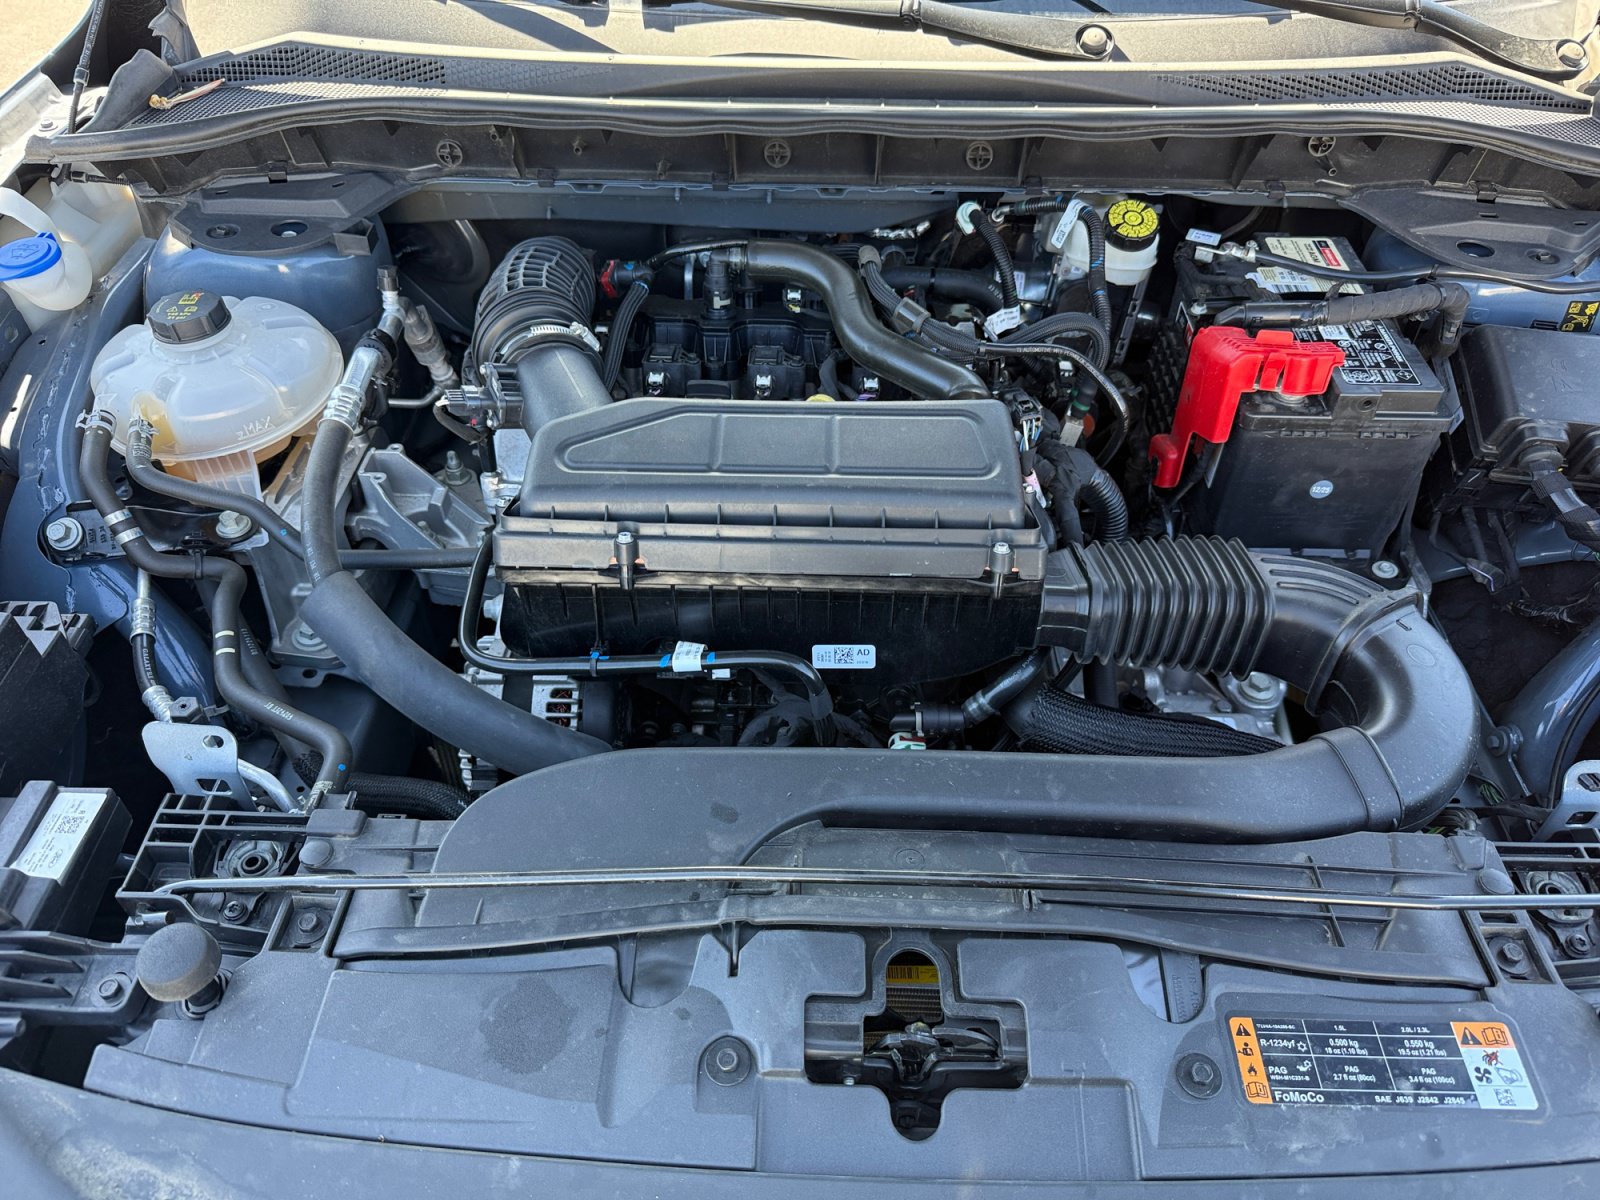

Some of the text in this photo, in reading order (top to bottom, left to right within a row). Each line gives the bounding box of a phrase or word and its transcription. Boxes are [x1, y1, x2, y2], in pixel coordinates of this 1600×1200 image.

[856, 648, 870, 656] AD
[1260, 1039, 1295, 1049] R-1234yf
[1329, 1038, 1359, 1048] 0.500 kg
[1404, 1040, 1435, 1049] 0.550 kg
[1268, 1066, 1288, 1074] PAG
[1333, 1073, 1342, 1081] 2.7
[1274, 1091, 1324, 1103] FoMoCo
[1374, 1095, 1392, 1103] SAE
